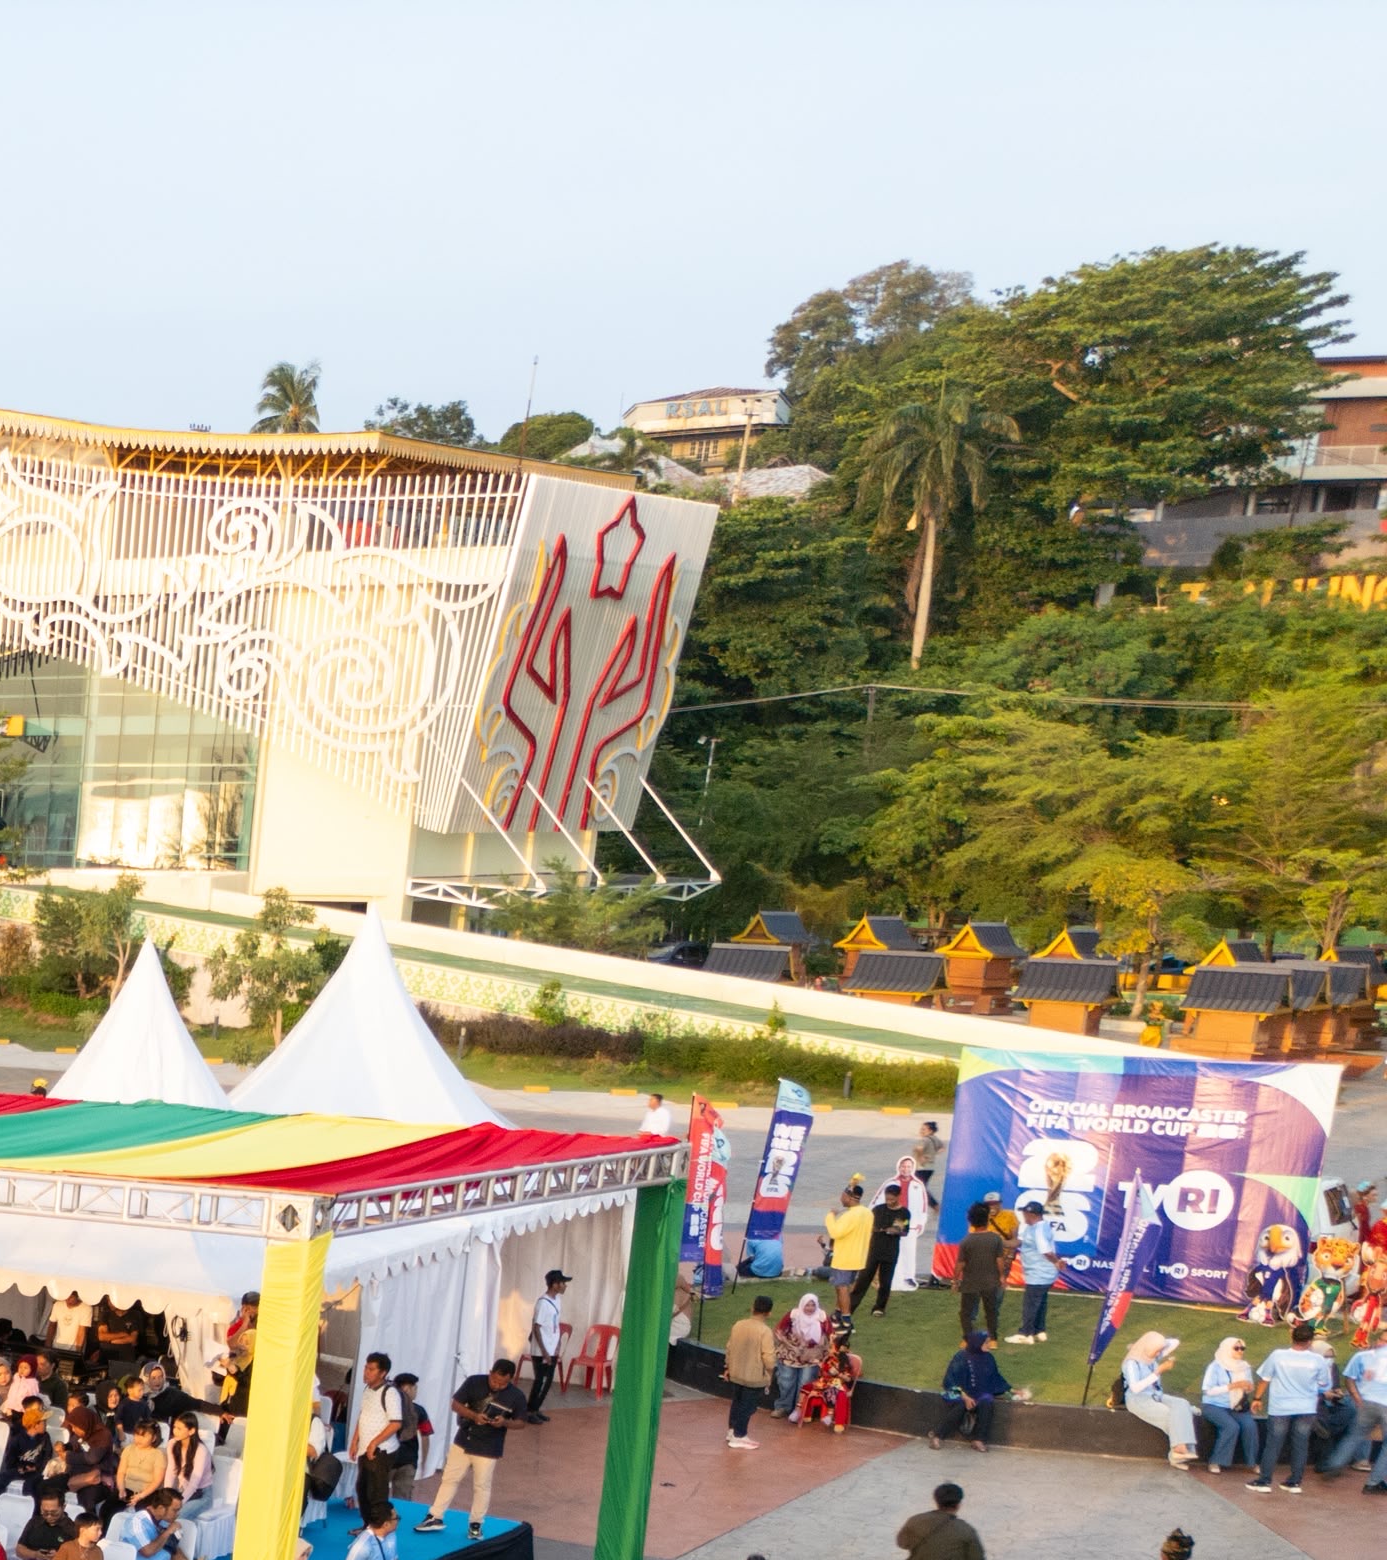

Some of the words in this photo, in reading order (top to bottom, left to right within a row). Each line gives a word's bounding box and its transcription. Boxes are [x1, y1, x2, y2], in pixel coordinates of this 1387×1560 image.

[666, 399, 727, 419] RSAL
[1029, 1099, 1109, 1116] OFFICIAL
[1112, 1104, 1248, 1125] BROADCASTER
[1026, 1113, 1069, 1130] FIFA
[1074, 1116, 1149, 1134] WORLD
[1151, 1122, 1195, 1137] CUP
[694, 1153, 708, 1190] WORLD
[1191, 1269, 1228, 1279] SPORT
